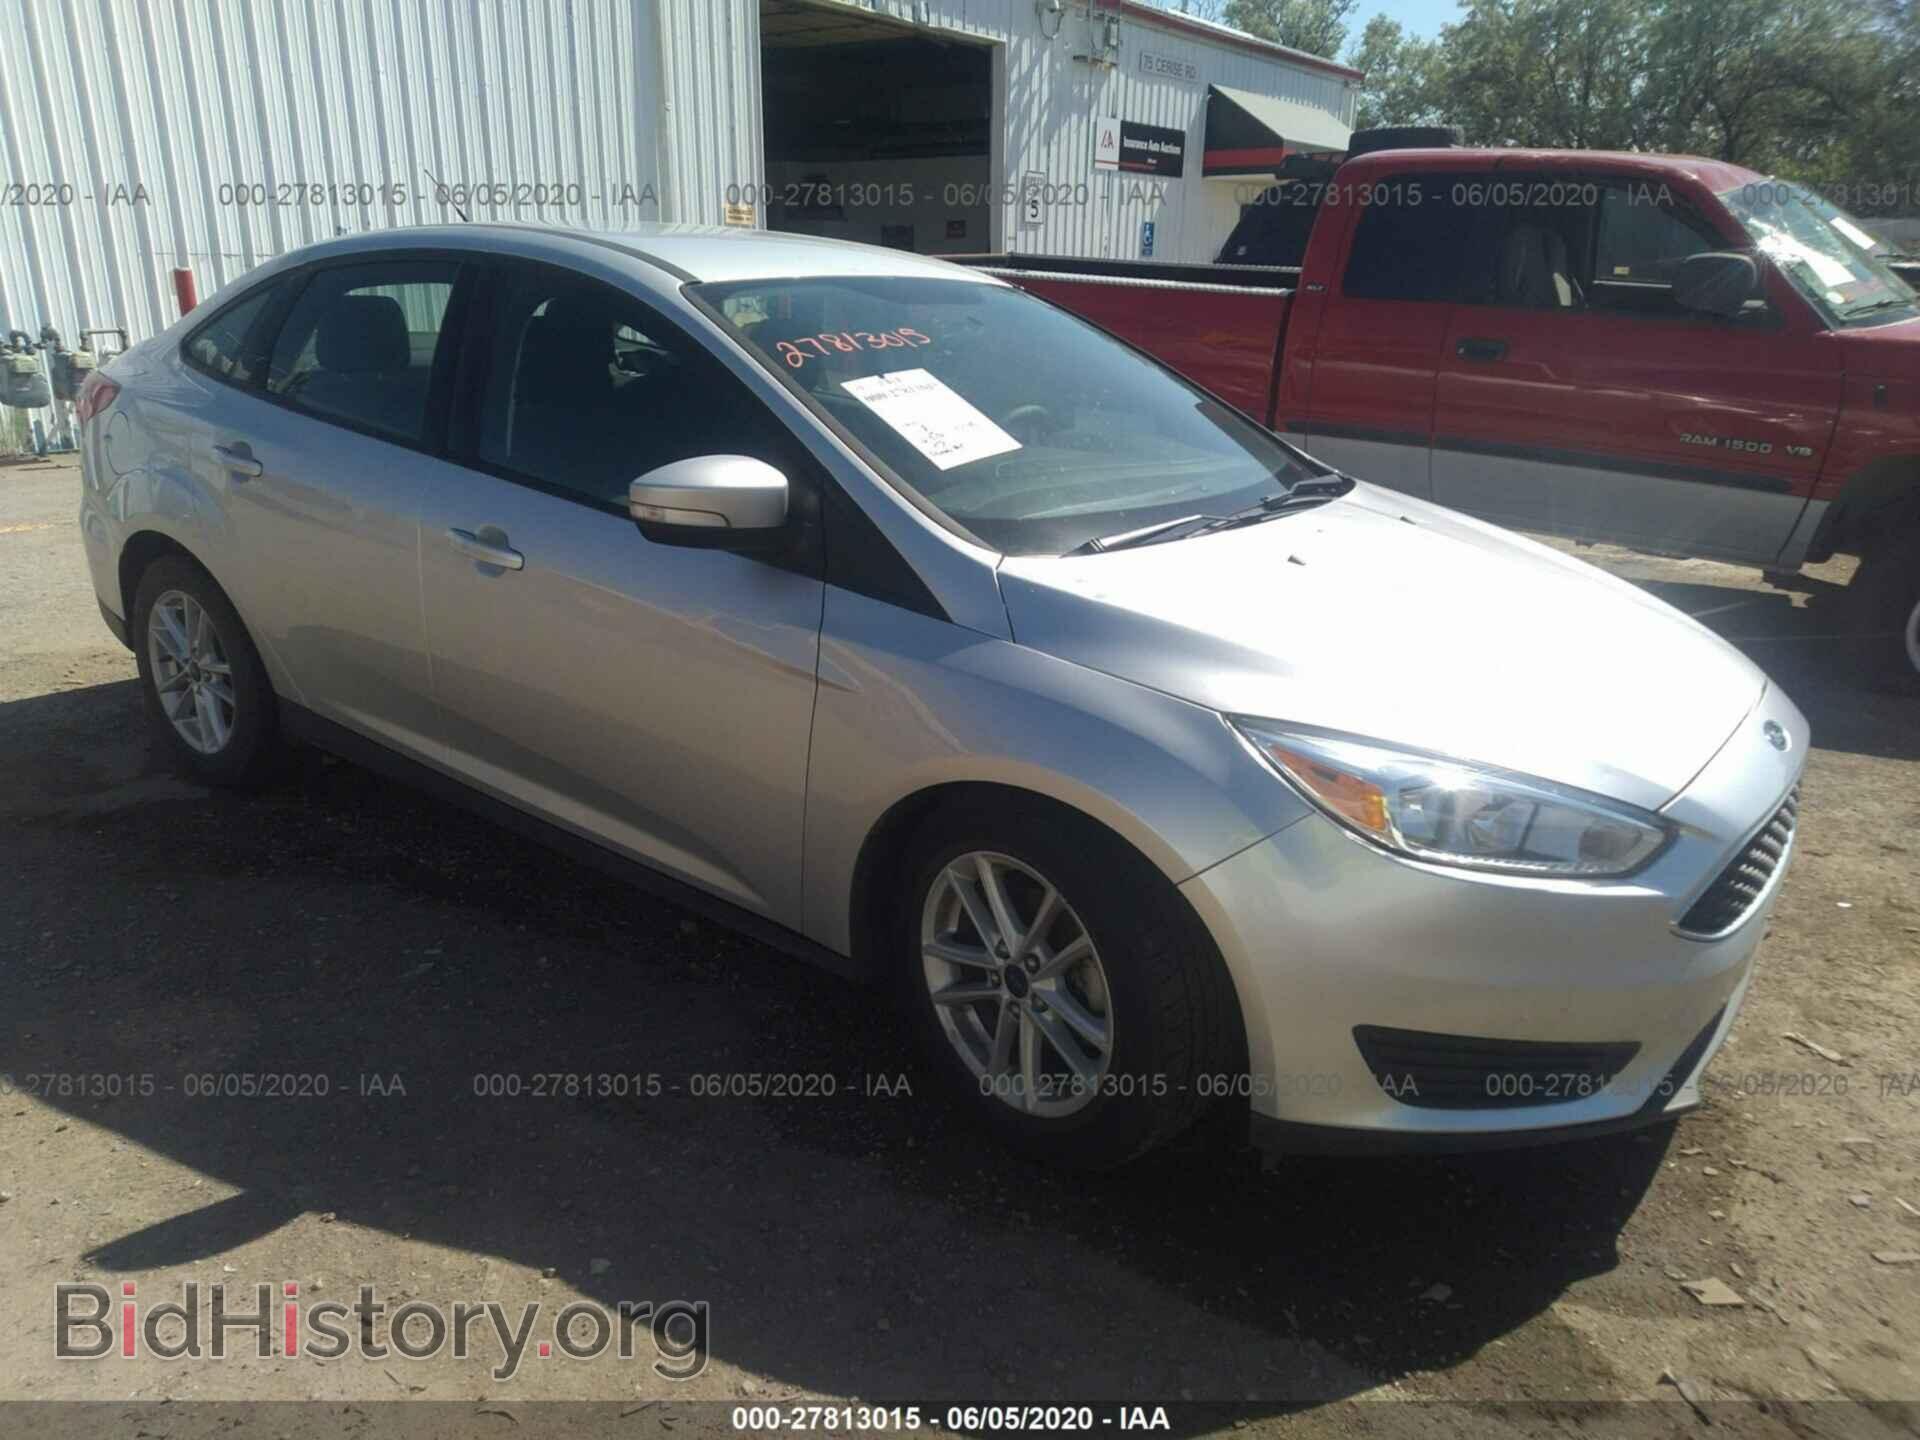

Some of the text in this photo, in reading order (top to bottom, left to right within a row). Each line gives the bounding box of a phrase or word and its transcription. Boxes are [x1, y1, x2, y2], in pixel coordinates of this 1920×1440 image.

[1030, 199, 1039, 218] 5
[776, 328, 931, 368] 27813015
[1679, 433, 1717, 447] RAM
[1725, 439, 1774, 454] 1500
